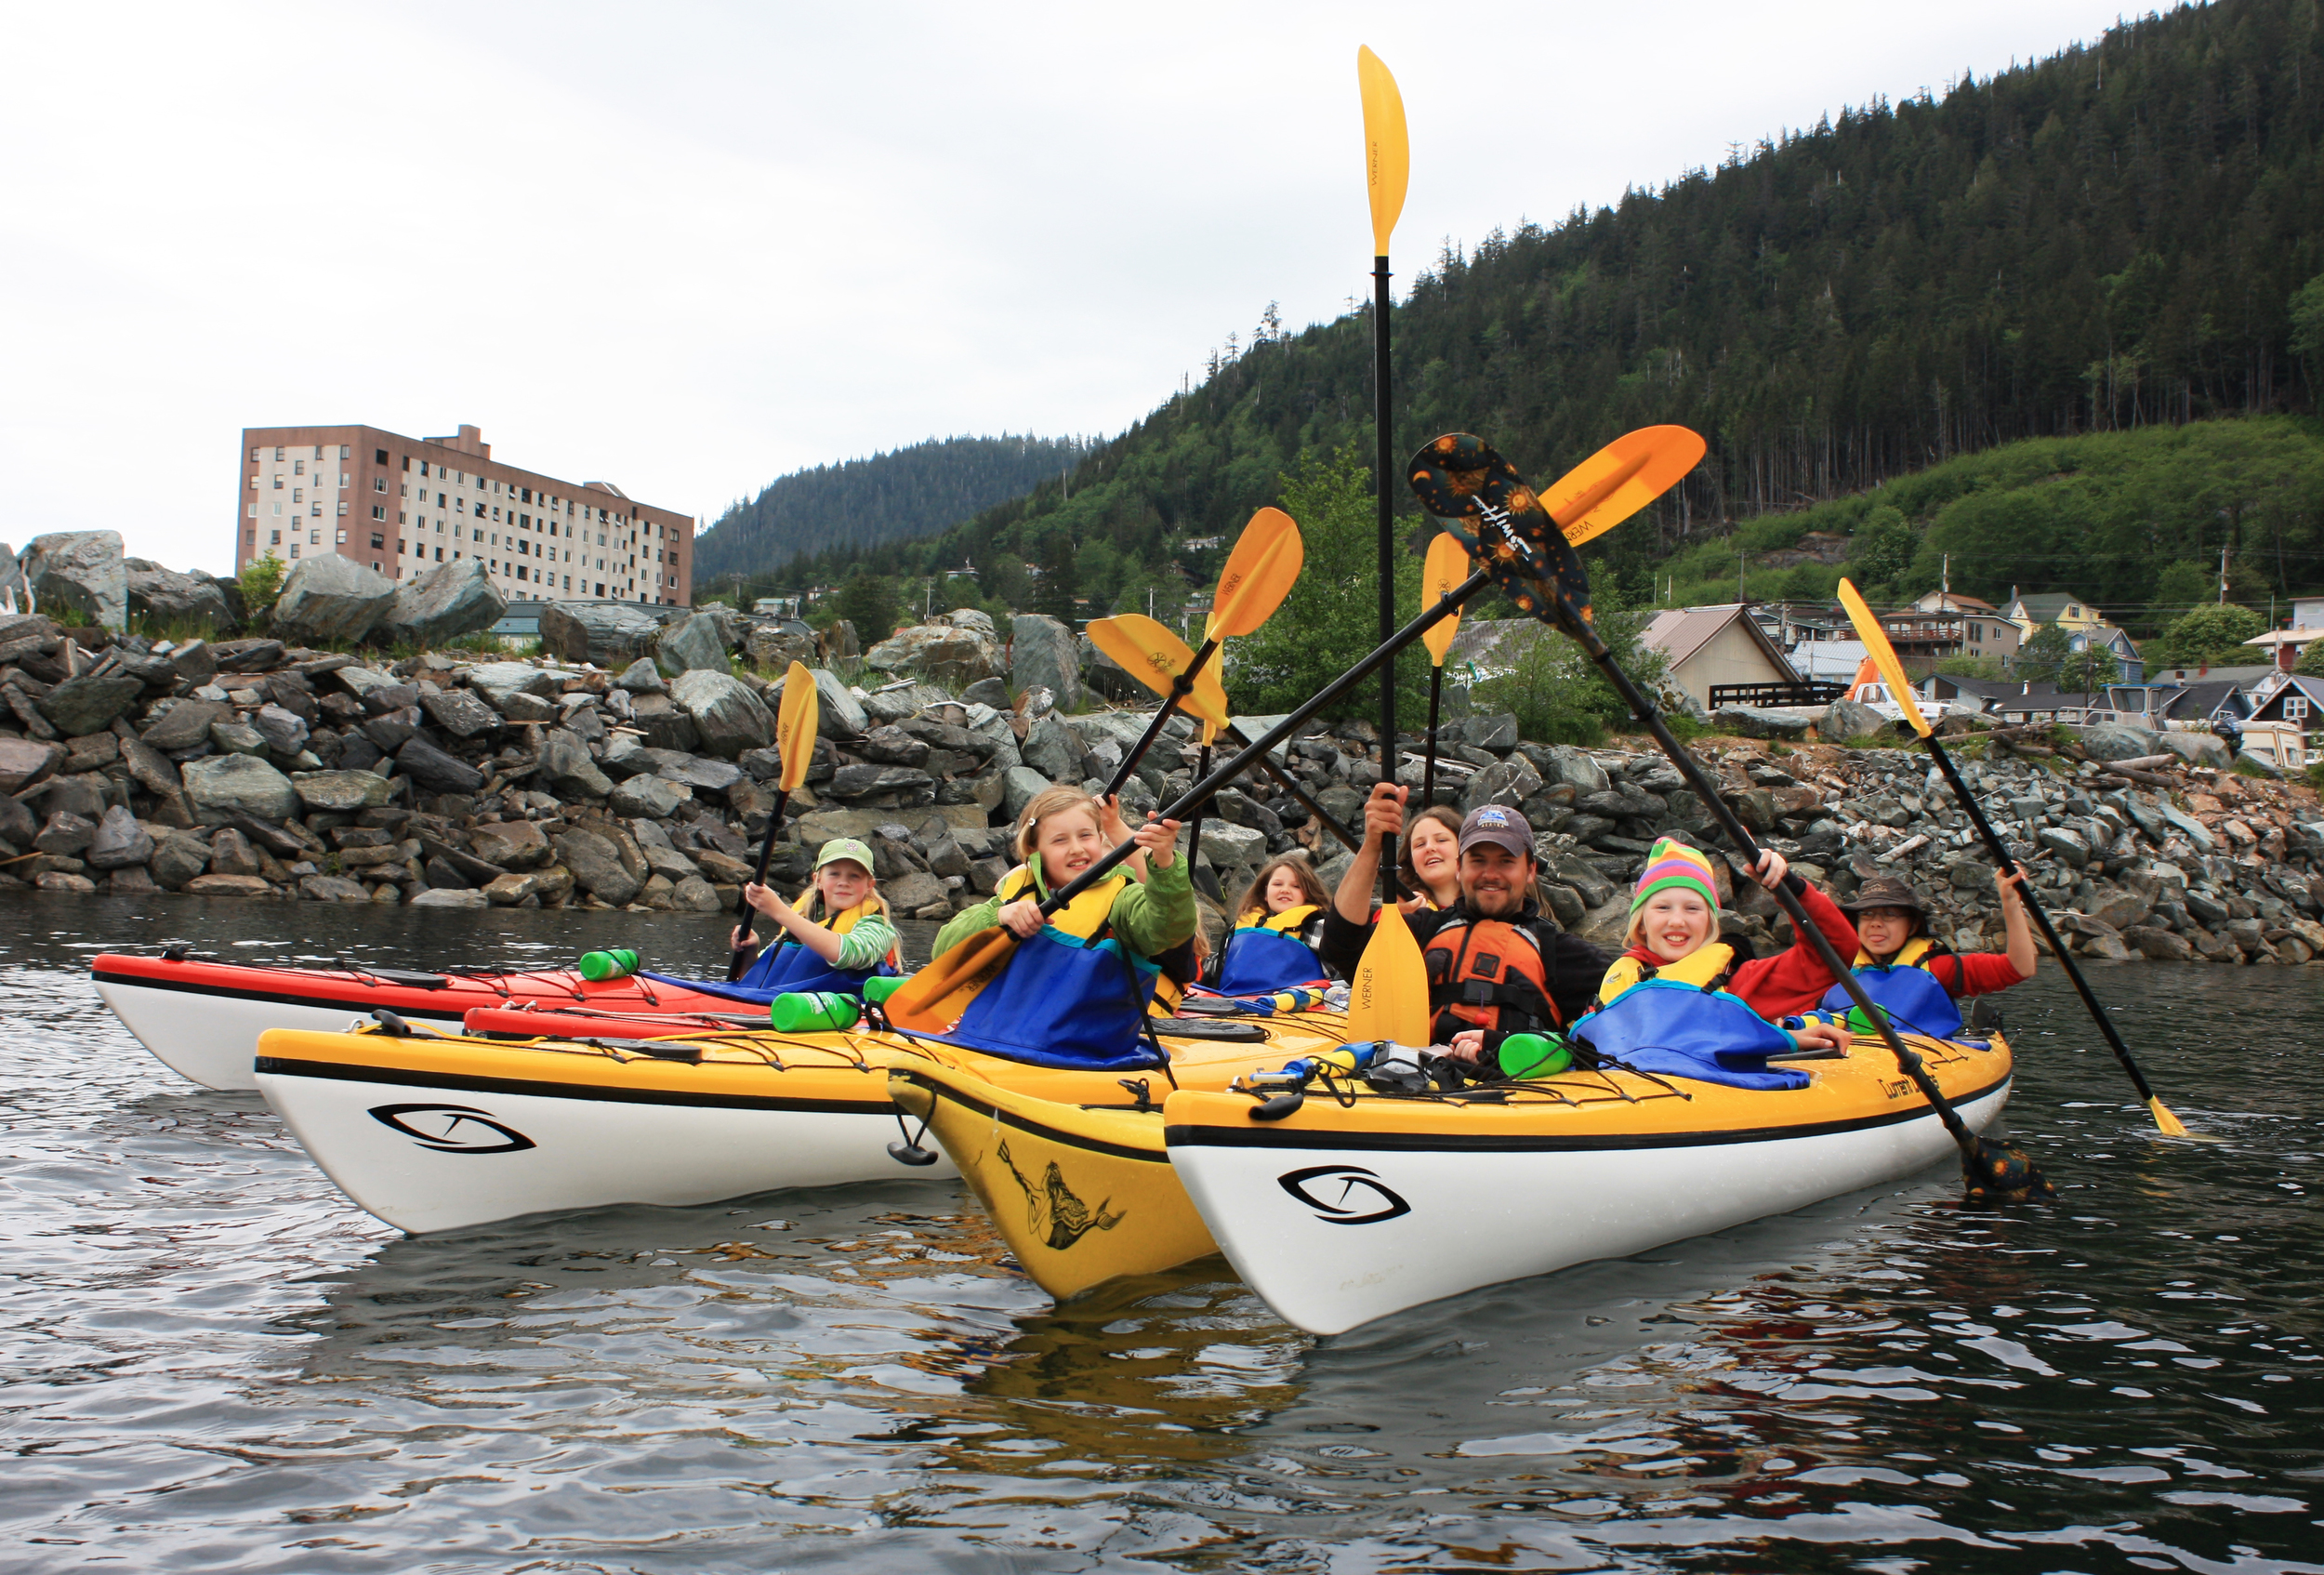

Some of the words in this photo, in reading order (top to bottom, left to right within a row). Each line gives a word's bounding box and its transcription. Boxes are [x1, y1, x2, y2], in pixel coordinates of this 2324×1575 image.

[1221, 573, 1242, 596] WERNER
[781, 721, 789, 745] WERNER
[965, 963, 997, 992] WERNER
[1361, 967, 1373, 1010] WERNER
